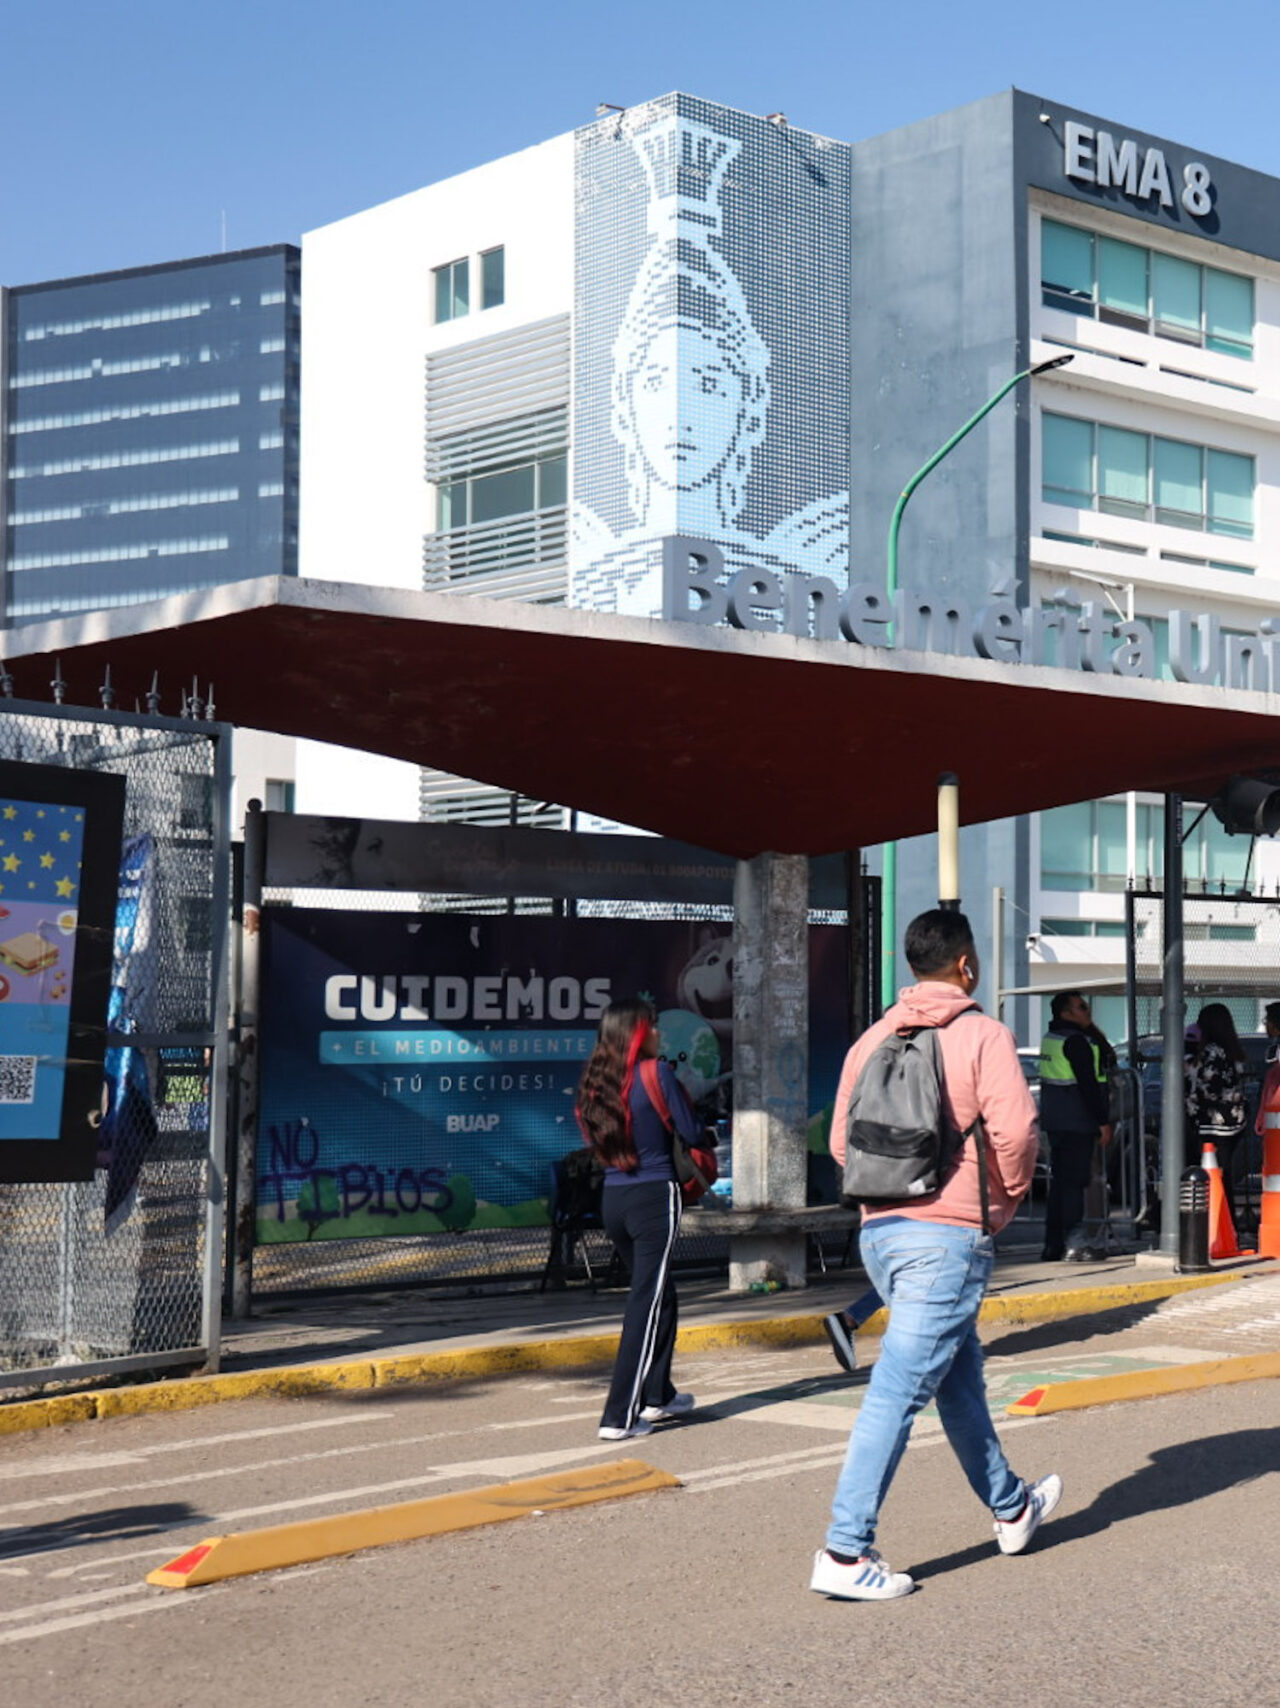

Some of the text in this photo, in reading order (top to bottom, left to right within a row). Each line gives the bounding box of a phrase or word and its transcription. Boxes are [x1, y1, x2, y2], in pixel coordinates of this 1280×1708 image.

[1064, 121, 1213, 216] EMA 8
[662, 535, 1156, 680] Benemérita
[325, 974, 612, 1022] CUIDEMOS
[353, 1037, 588, 1056] EL MEDIOAMBIENTE
[382, 1073, 554, 1097] ¡TÚ DECIDES!
[268, 1117, 320, 1172] NO
[446, 1113, 500, 1133] BUAP
